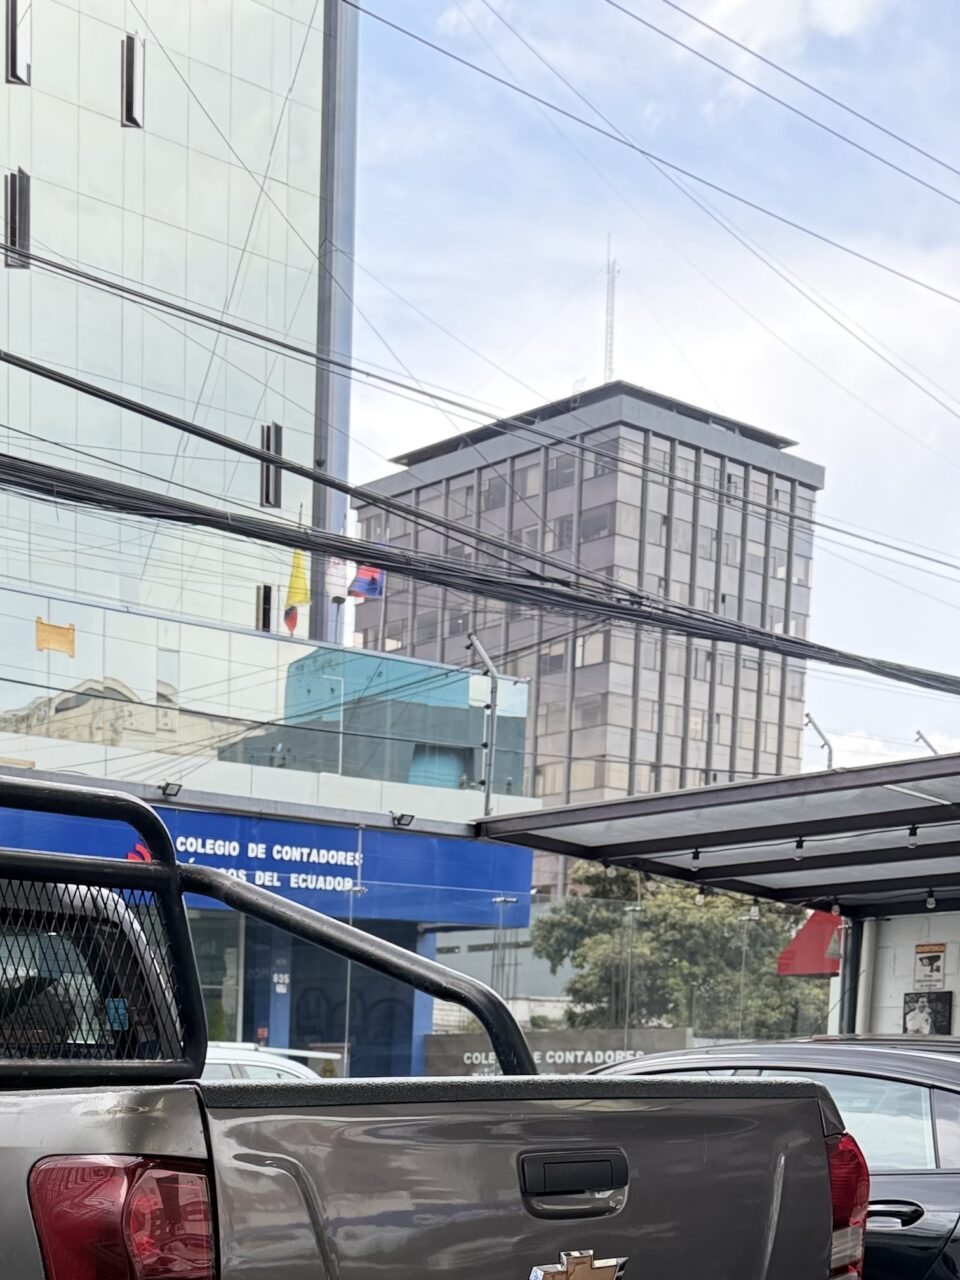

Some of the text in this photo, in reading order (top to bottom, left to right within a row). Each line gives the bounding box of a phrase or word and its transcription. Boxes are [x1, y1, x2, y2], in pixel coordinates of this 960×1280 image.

[176, 836, 363, 866] COLEGIO DE CONTADORES
[255, 870, 353, 892] DEL ECUADOR
